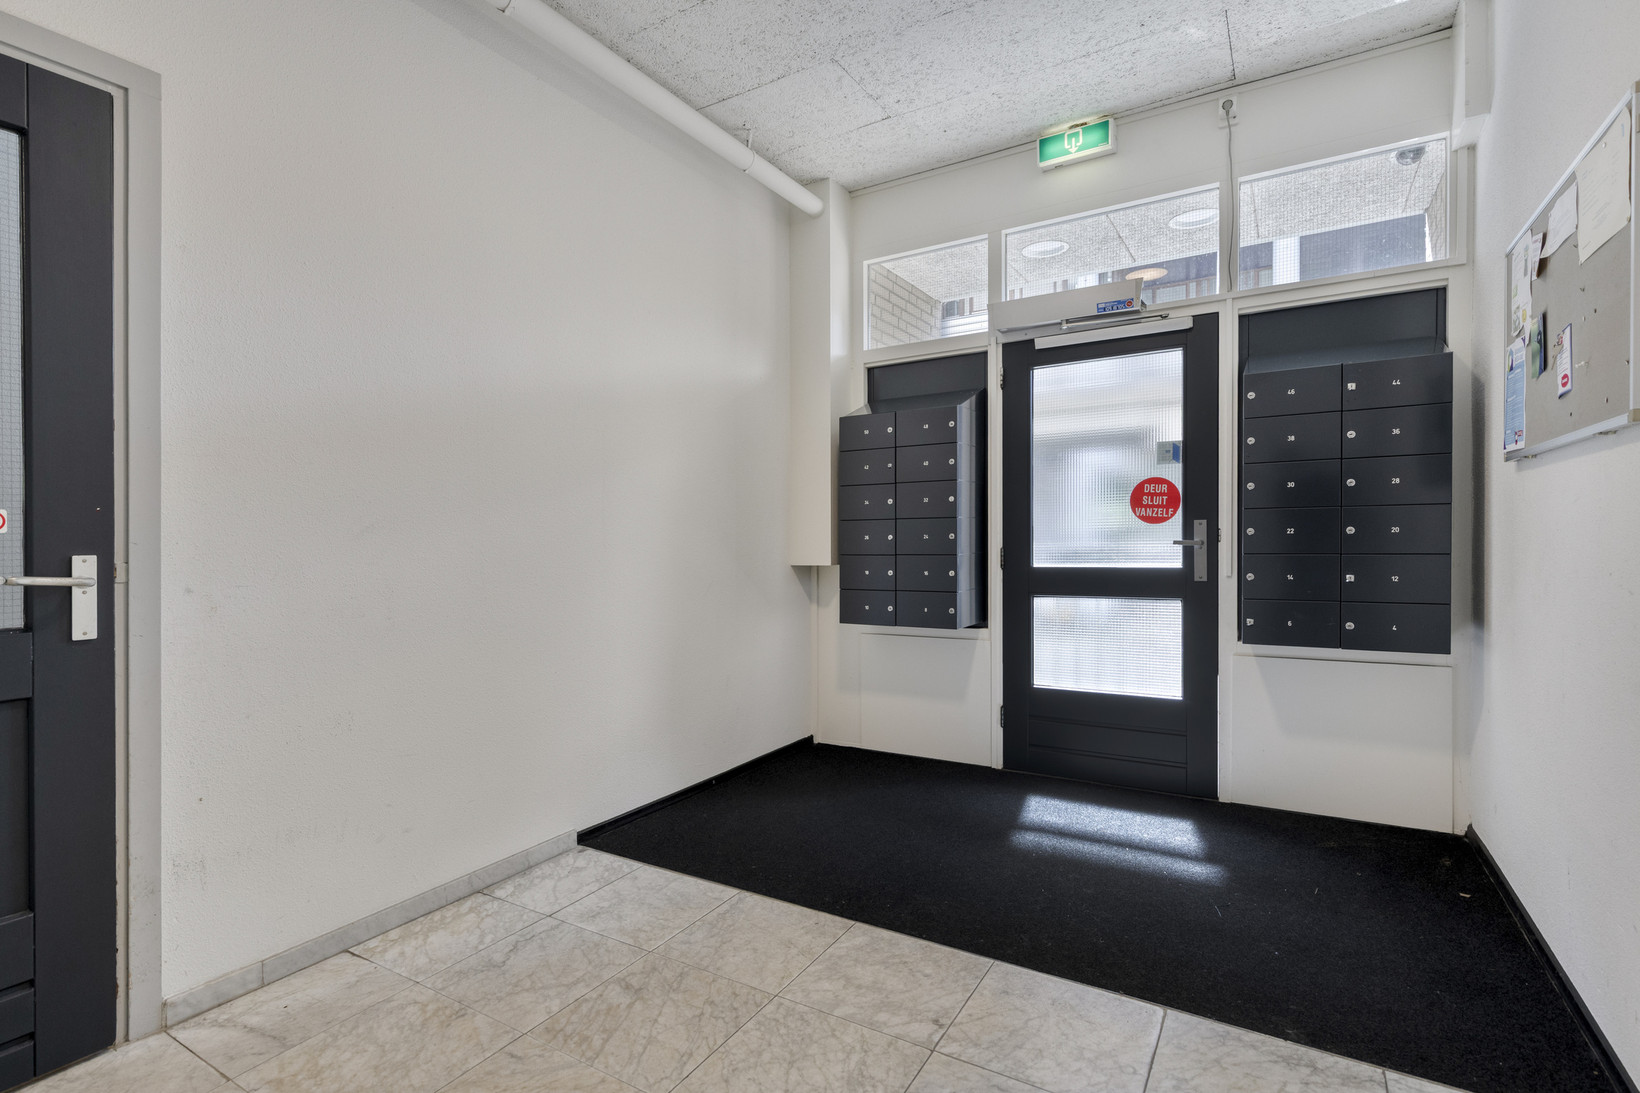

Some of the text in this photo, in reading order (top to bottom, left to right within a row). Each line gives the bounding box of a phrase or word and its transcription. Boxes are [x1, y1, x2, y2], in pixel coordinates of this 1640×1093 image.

[1144, 484, 1168, 493] DEUR
[1142, 496, 1168, 505] SLUIT
[1135, 508, 1174, 517] VANZELF
